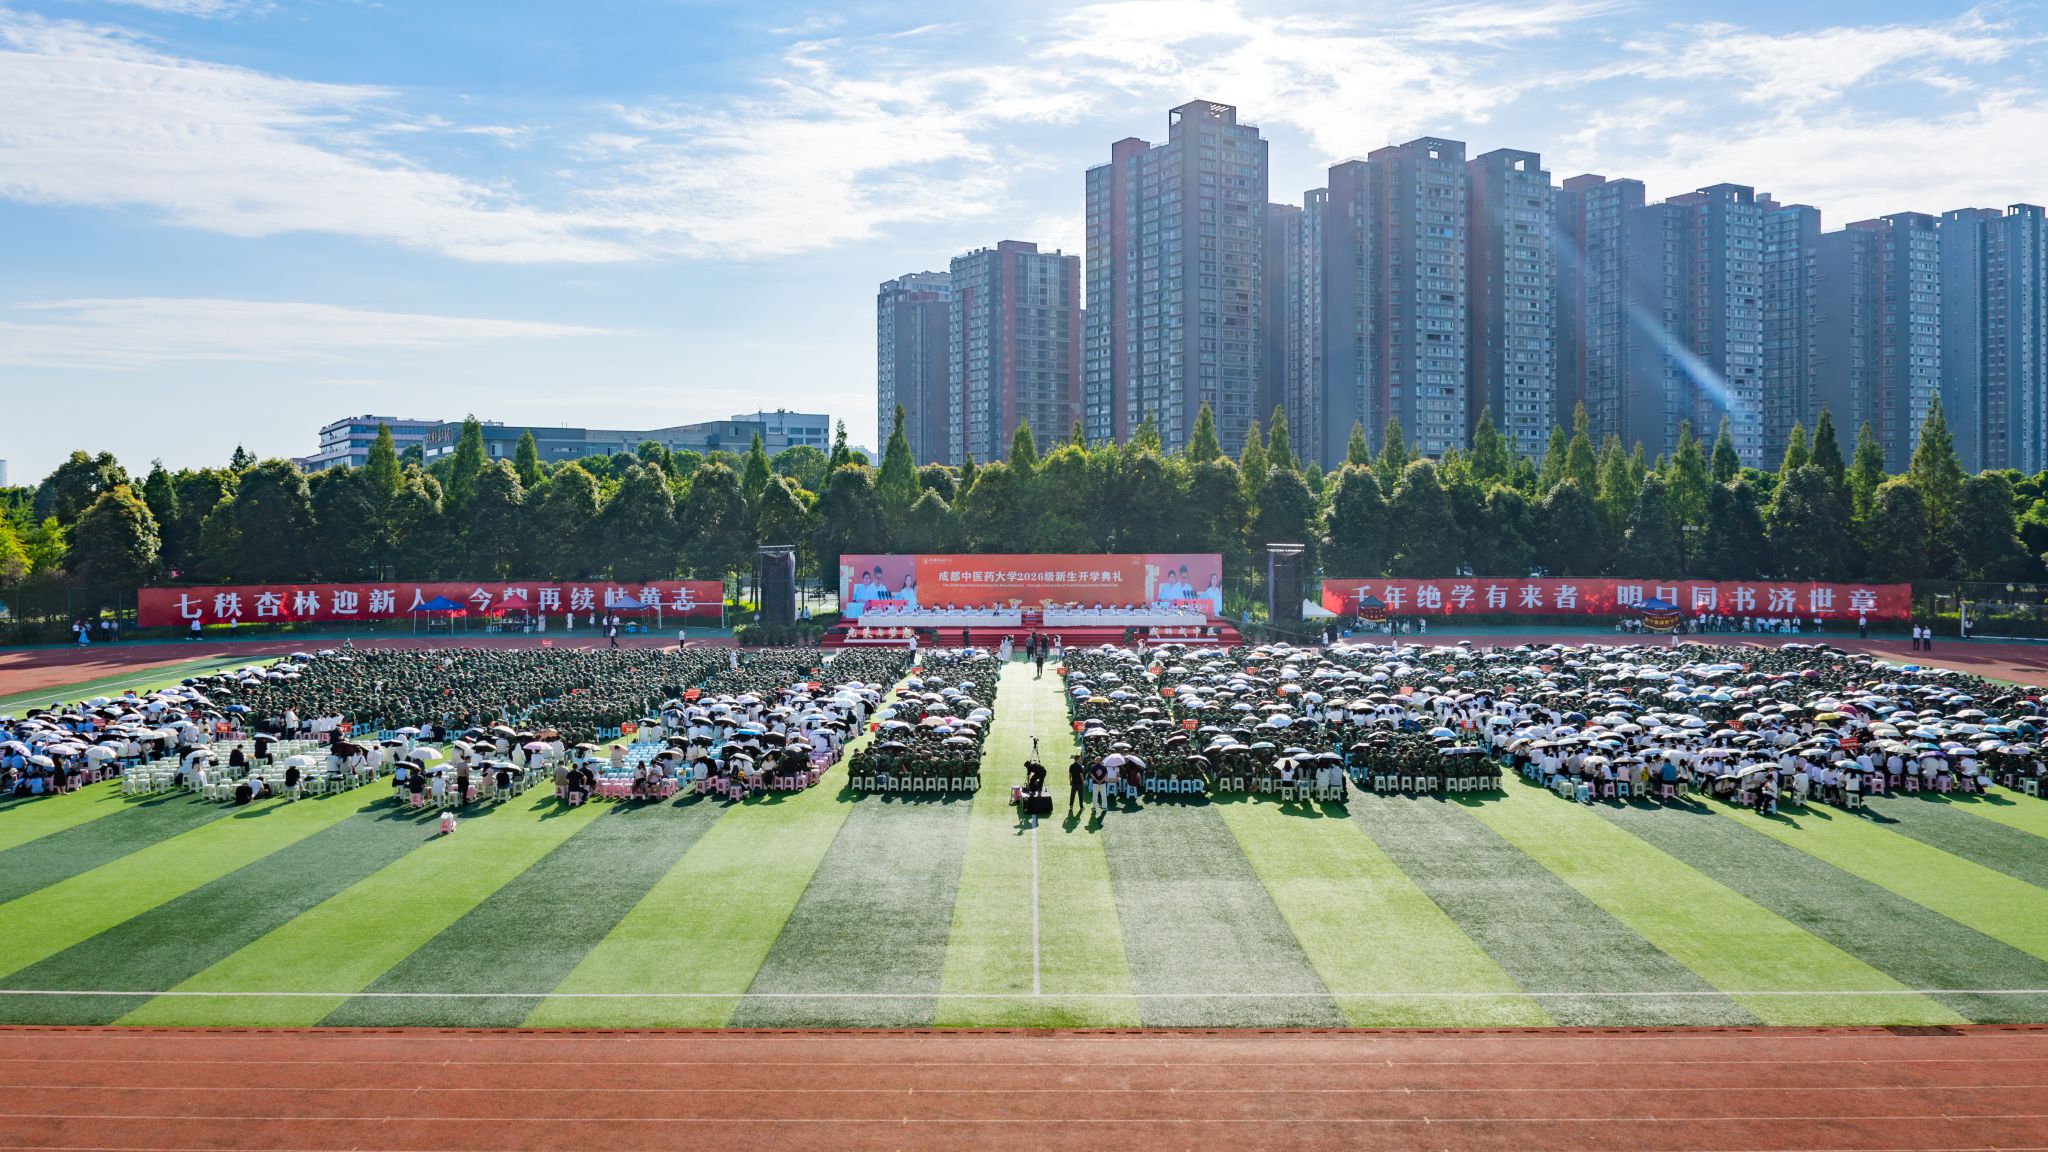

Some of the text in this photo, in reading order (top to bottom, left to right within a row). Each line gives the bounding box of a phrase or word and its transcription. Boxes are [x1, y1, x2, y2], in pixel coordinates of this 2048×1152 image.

[938, 571, 1123, 582] 成都中医药大学2026级新生开学典礼
[173, 588, 428, 619] 七秩杏林迎新人
[1350, 585, 1878, 615] 千年绝学有来者 明日同书济世章
